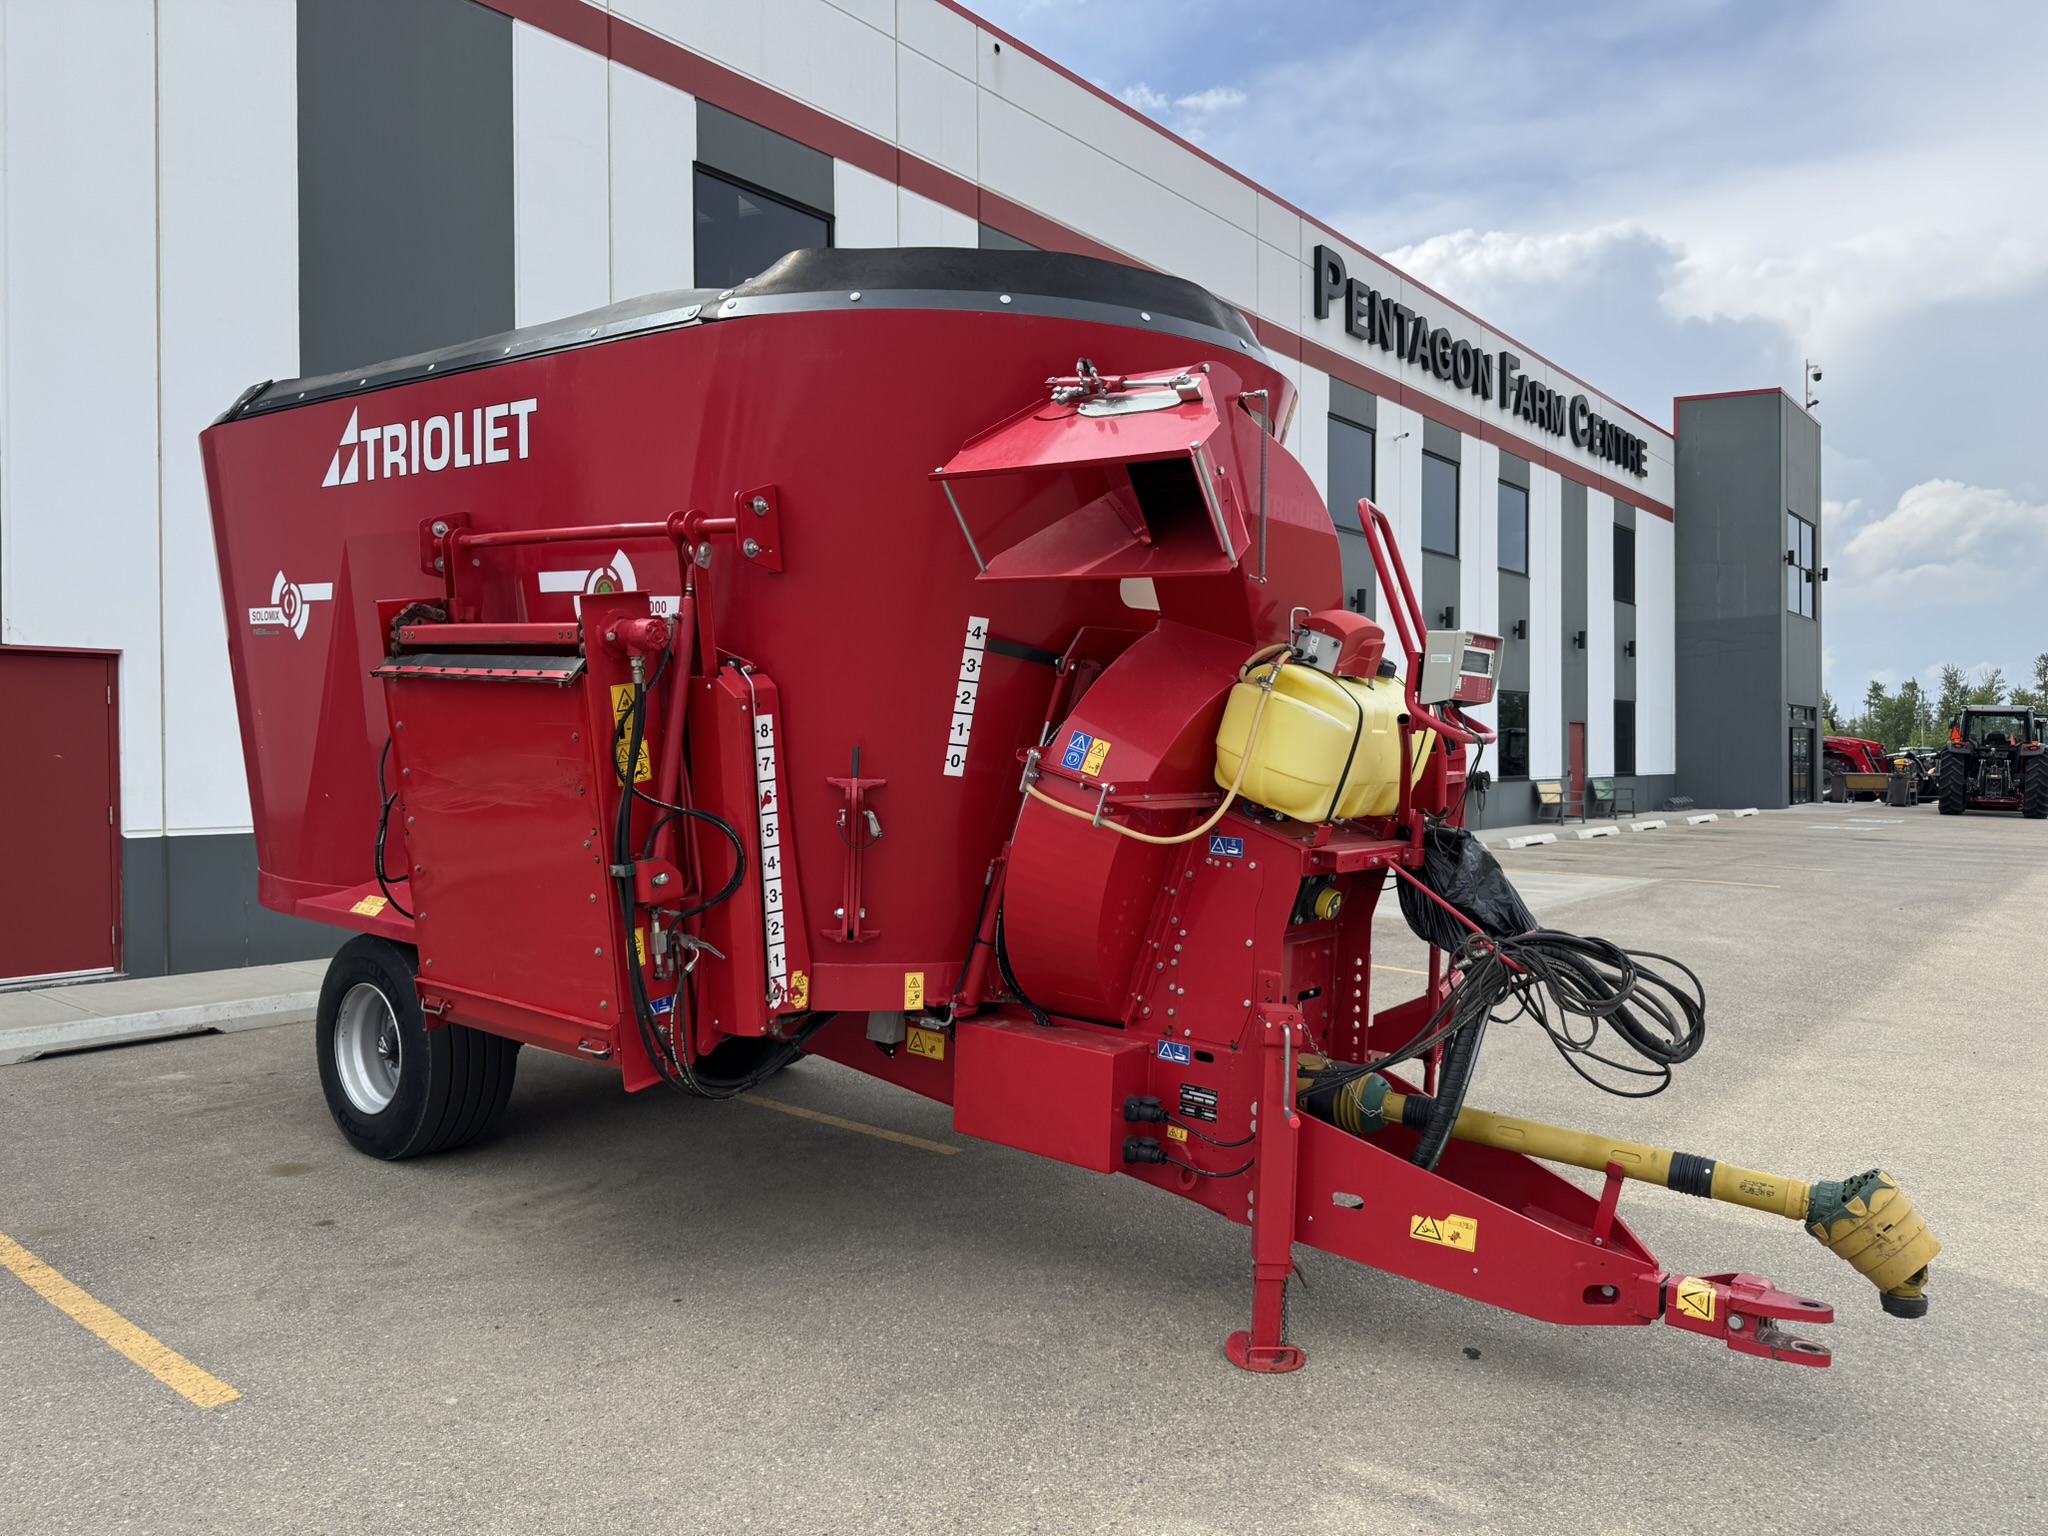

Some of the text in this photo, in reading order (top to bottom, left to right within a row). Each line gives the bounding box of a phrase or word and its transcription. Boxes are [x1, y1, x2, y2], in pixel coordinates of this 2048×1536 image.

[1314, 244, 1648, 478] PENTAGON FARM CENTRE
[360, 398, 538, 482] TRIOLIET
[252, 610, 280, 622] SOLOMIX
[971, 625, 982, 640] 4
[965, 658, 977, 673] 3
[960, 690, 972, 705] 2
[760, 723, 769, 738] 8
[761, 756, 771, 771] 7
[950, 753, 961, 768] 0
[765, 822, 774, 838] 5
[767, 855, 777, 870] 4
[769, 888, 778, 903] 3
[771, 921, 780, 936] 2
